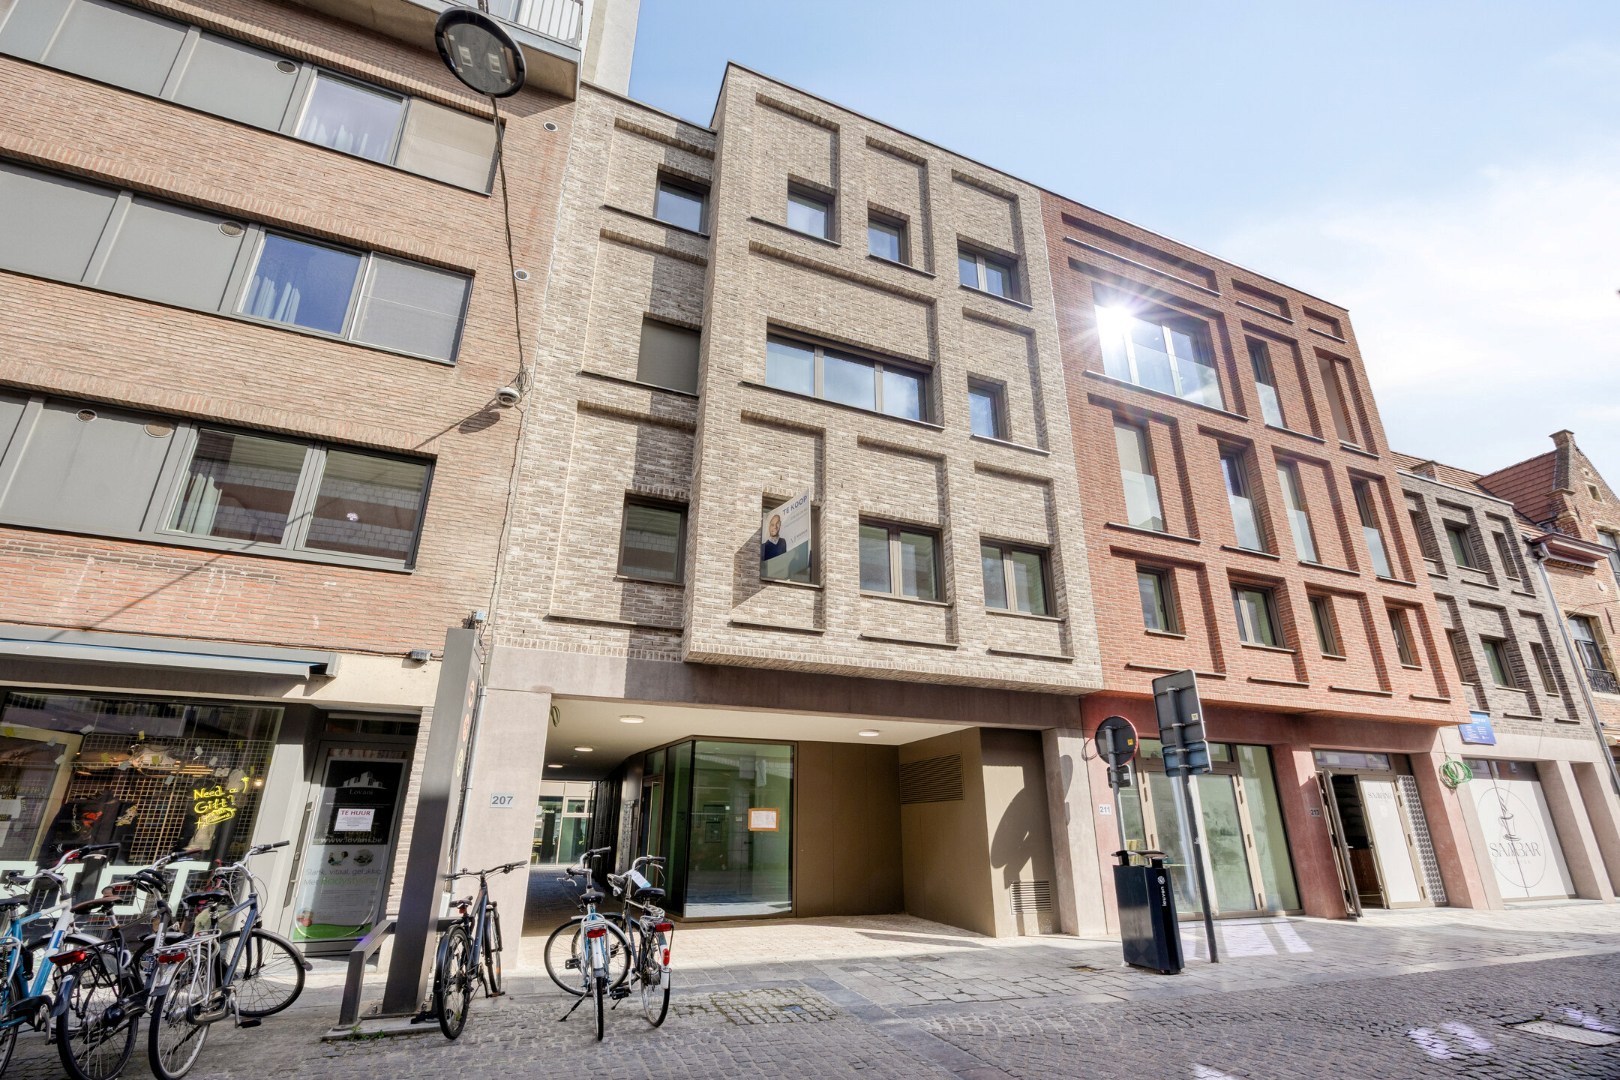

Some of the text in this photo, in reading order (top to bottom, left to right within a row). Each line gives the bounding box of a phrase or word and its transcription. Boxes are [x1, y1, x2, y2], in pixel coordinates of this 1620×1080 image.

[783, 495, 808, 516] TE KOOP
[193, 785, 225, 800] Need
[349, 788, 374, 796] Lovani
[491, 795, 514, 805] 207
[1489, 841, 1542, 857] SAMBAR
